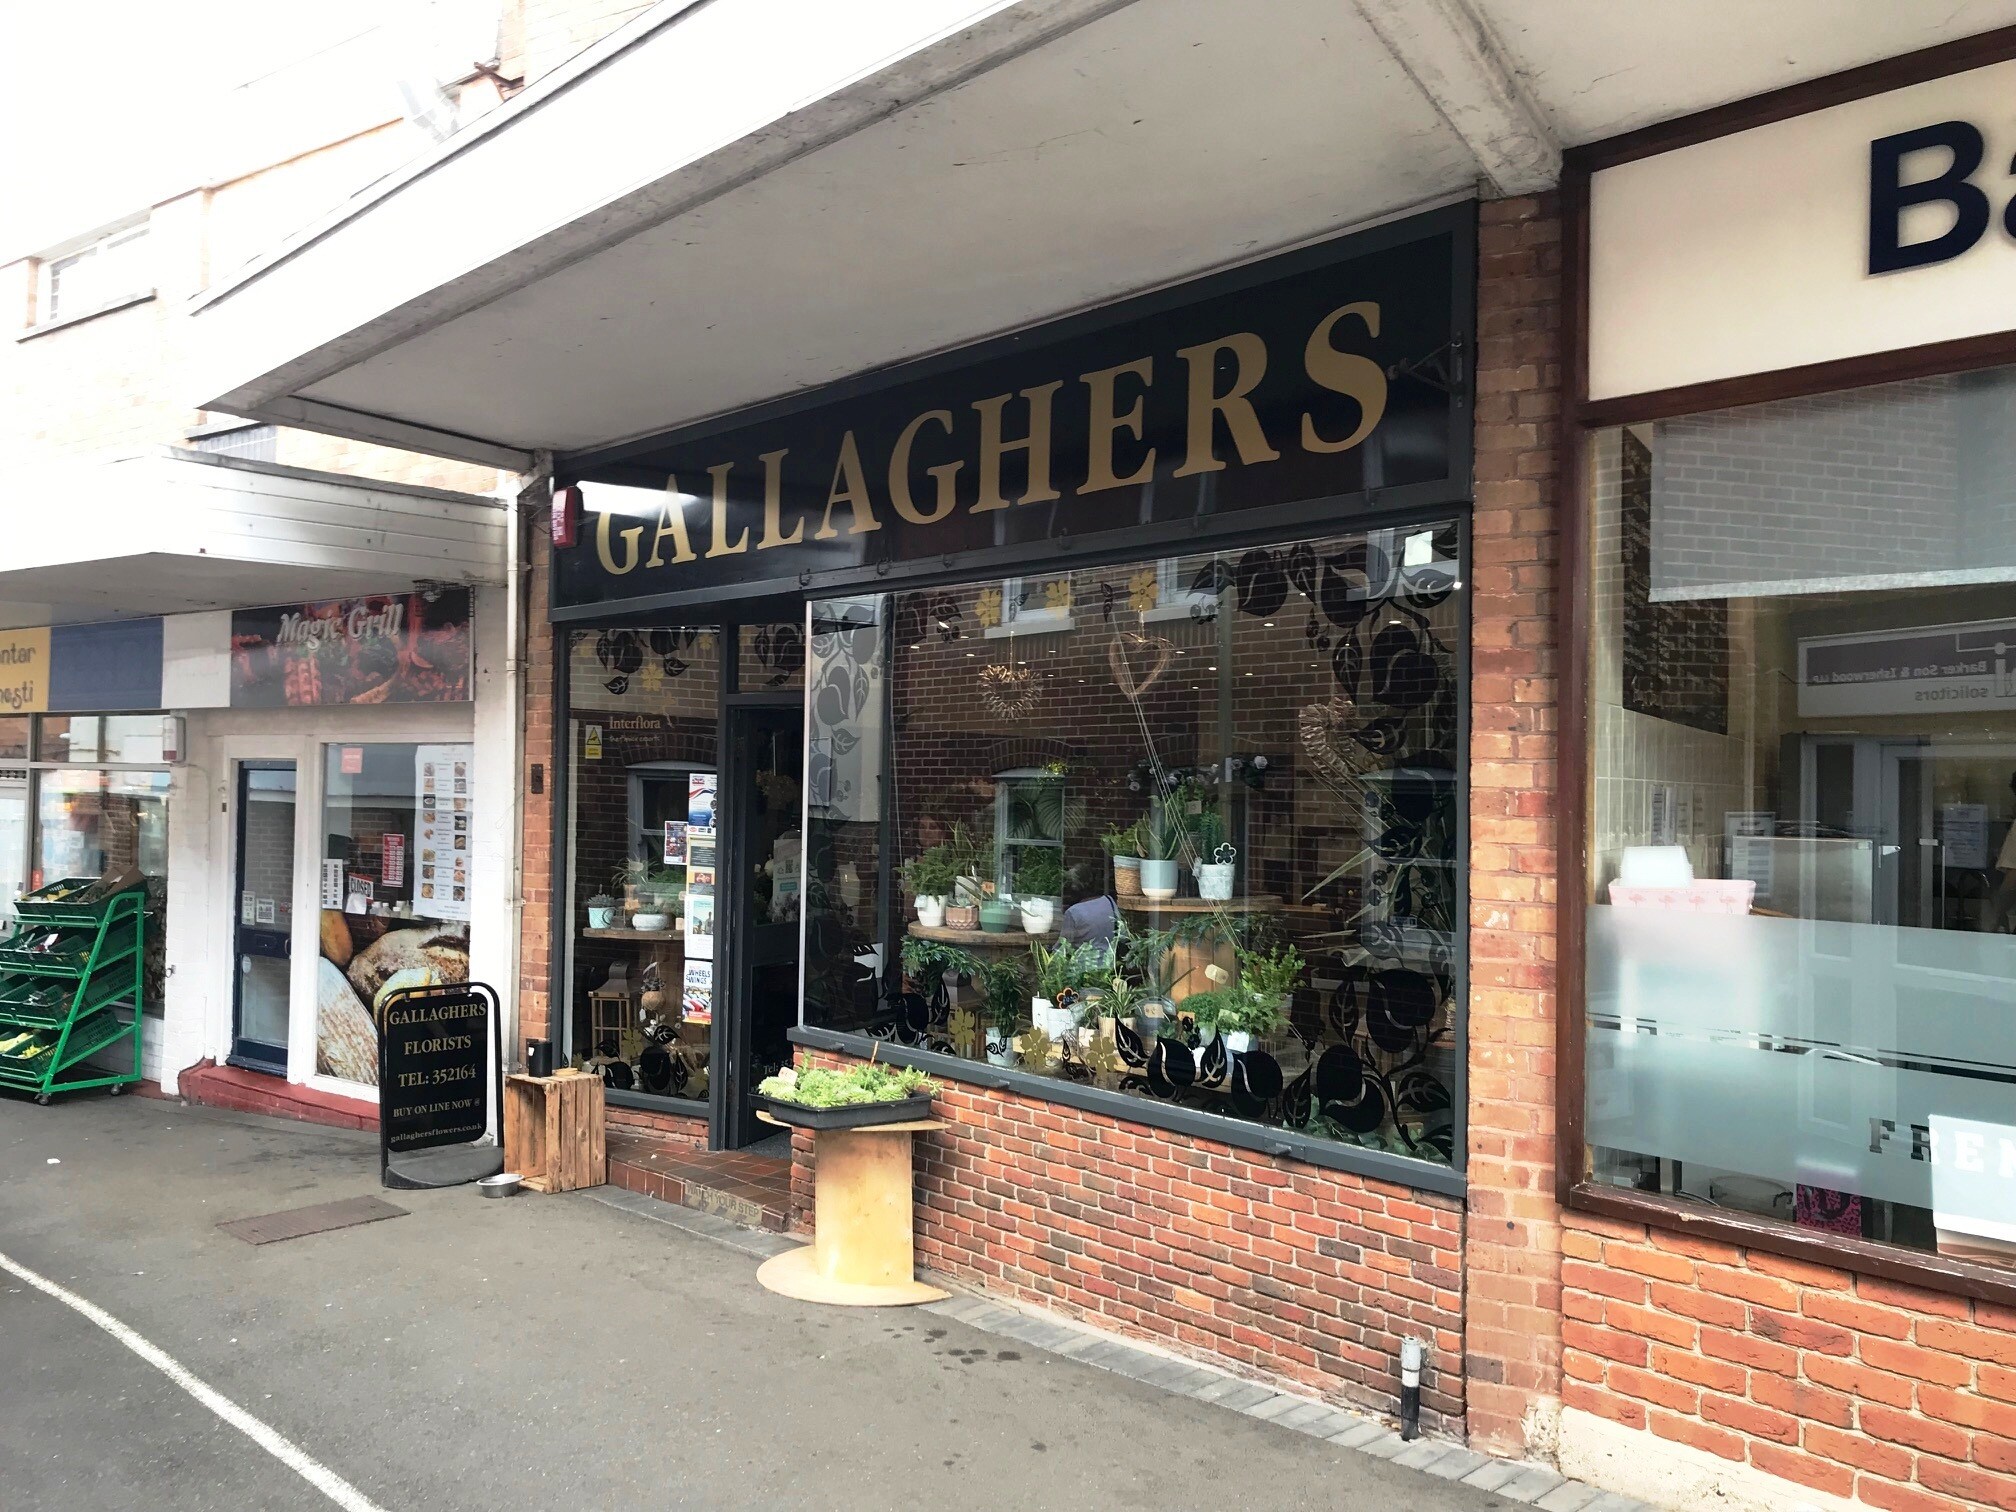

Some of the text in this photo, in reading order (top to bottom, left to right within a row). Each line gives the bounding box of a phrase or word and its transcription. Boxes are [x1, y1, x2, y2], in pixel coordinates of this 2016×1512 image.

[1868, 119, 2016, 276] B
[596, 301, 1390, 575] GALLAGHERS
[277, 602, 404, 650] Magic Grill
[609, 715, 662, 729] Interflora
[389, 1003, 487, 1025] GALLAGHERS
[404, 1034, 472, 1056] FLORISTS
[398, 1063, 477, 1088] TEL: 352164
[393, 1106, 413, 1118] BUY
[414, 1104, 428, 1115] ON
[429, 1101, 451, 1113] LINE
[452, 1098, 473, 1110] NOW
[390, 1122, 482, 1144] gallaghersflowers.co.uk
